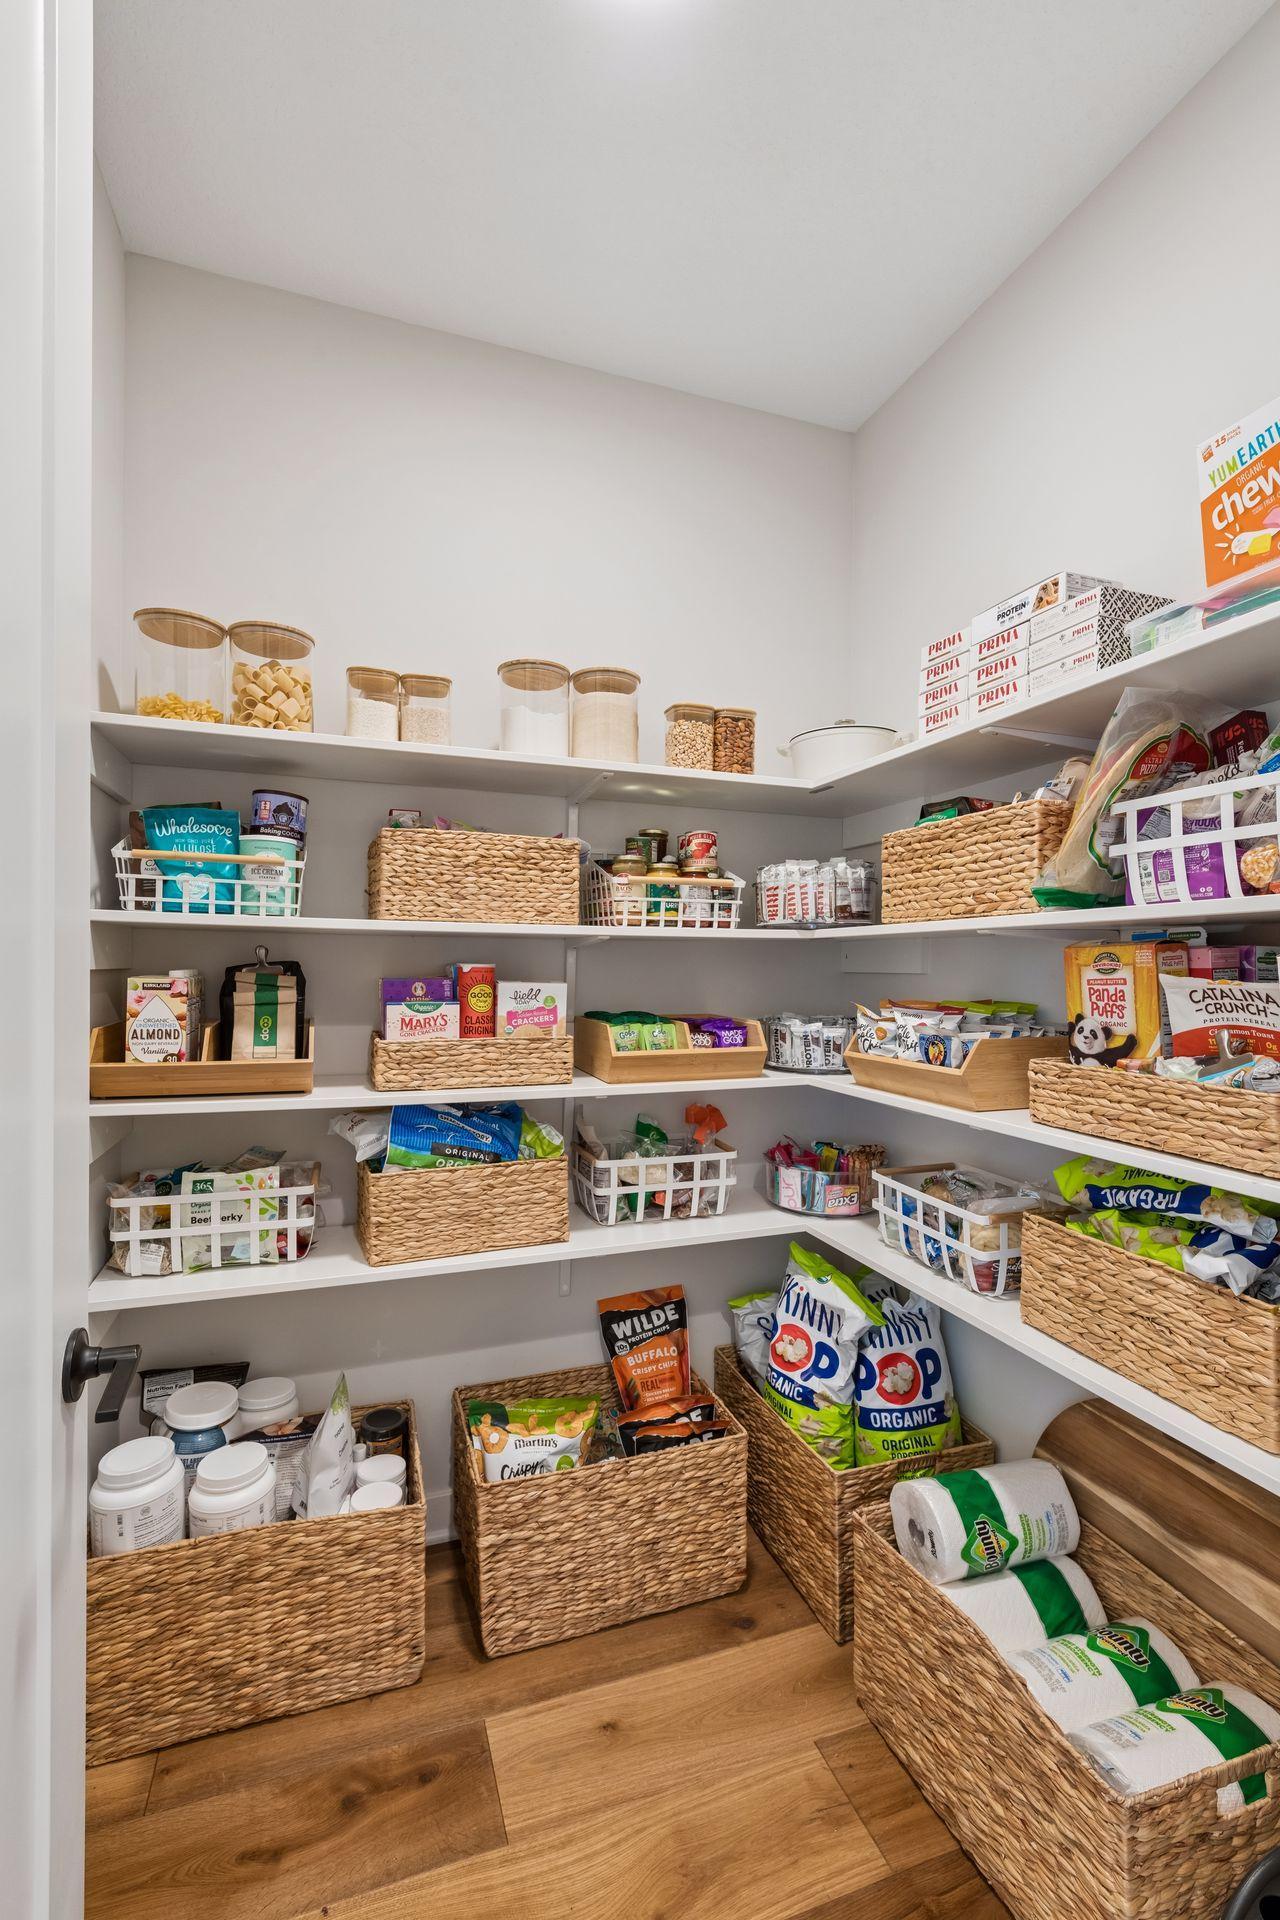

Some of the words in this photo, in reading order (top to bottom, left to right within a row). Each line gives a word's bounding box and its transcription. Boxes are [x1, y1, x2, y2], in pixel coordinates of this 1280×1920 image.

[1236, 459, 1266, 487] ORGANIC
[927, 632, 962, 656] PRIMA
[978, 628, 1019, 655] PRIMA
[926, 657, 960, 681] PRIMA
[977, 655, 1017, 681] PRIMA
[925, 682, 958, 705] PRIMA
[978, 681, 1018, 706] PRIMA
[925, 705, 959, 727] PRIMA
[260, 826, 281, 836] Baking
[172, 844, 216, 853] ALLULOSE
[251, 867, 262, 876] ICE
[262, 868, 284, 877] CREAM
[1189, 987, 1280, 1008] CATALINA
[400, 1013, 448, 1031] MARY'S
[512, 1014, 554, 1026] CRACKERS
[1243, 1018, 1278, 1029] CEREAL
[131, 1028, 180, 1041] ALMOND
[417, 1027, 447, 1036] CRACKERS
[721, 1029, 743, 1038] MADE
[1250, 1029, 1275, 1040] Toast
[723, 1036, 744, 1045] GOOD
[140, 1047, 169, 1055] Vanilla
[824, 1039, 832, 1066] OTEIN
[445, 1148, 490, 1161] ORIGINAL
[194, 1181, 212, 1192] 365
[221, 1213, 243, 1222] erky
[611, 1303, 680, 1340] WILDE
[628, 1331, 653, 1344] PROTEIN
[653, 1324, 670, 1335] CHIPS
[627, 1346, 678, 1366] BUFFALO
[632, 1364, 657, 1376] CRISPY
[658, 1360, 679, 1370] CHIPS
[147, 1385, 174, 1394] Nutrition
[640, 1378, 661, 1392] REAL
[870, 1407, 938, 1429] ORGANIC
[882, 1434, 936, 1451] ORIGINAL
[500, 1460, 540, 1480] Crispy
[974, 1520, 1000, 1572] Bounty
